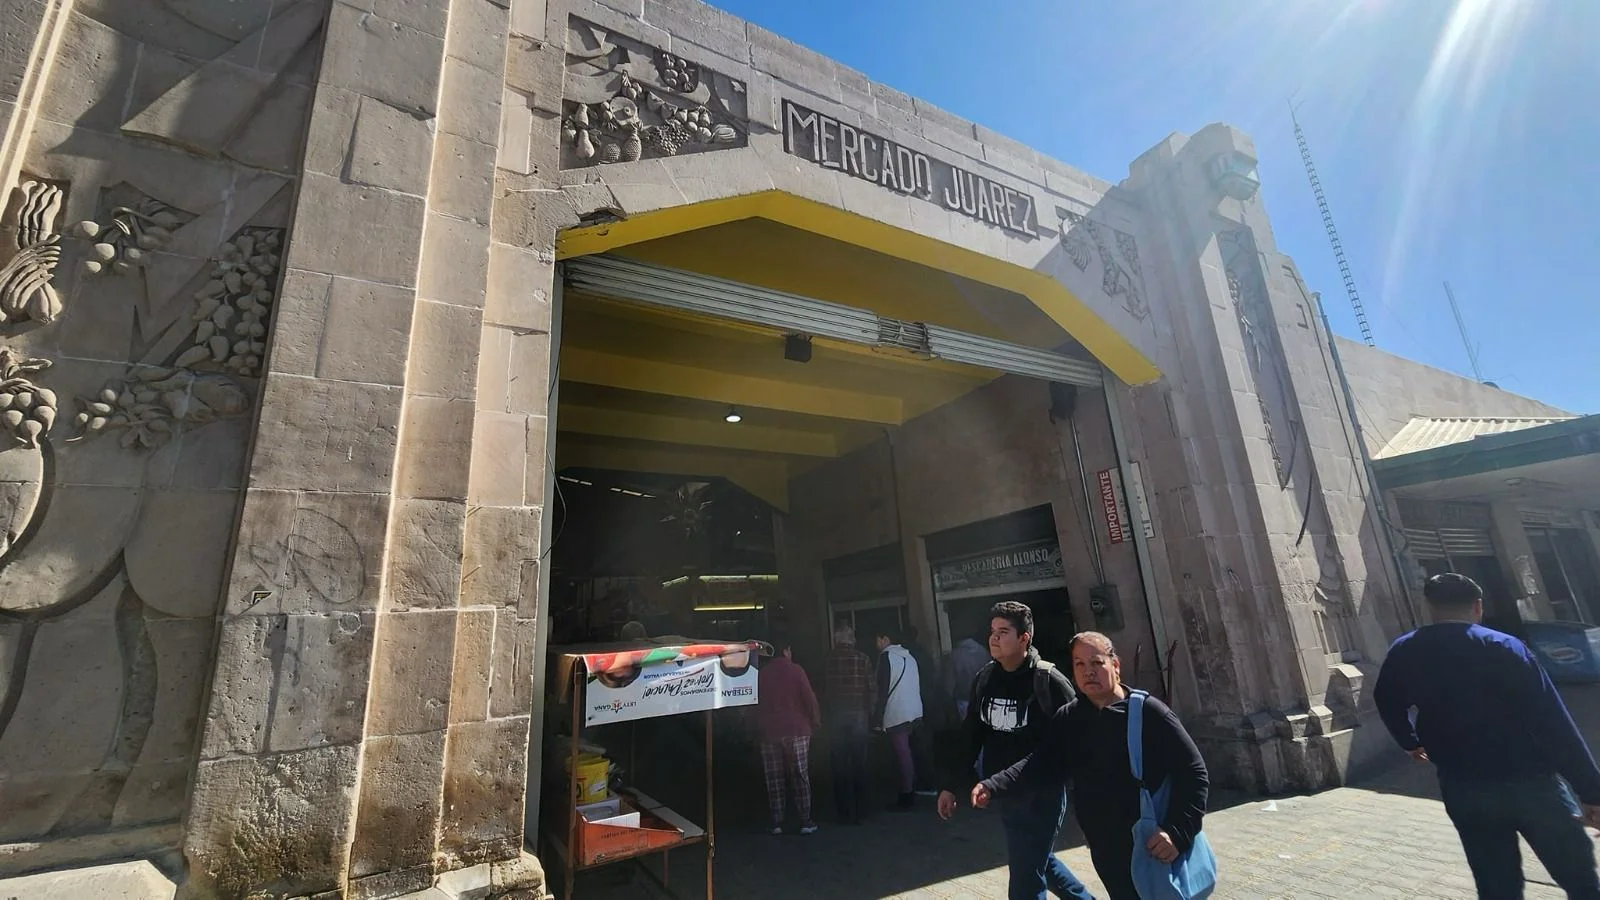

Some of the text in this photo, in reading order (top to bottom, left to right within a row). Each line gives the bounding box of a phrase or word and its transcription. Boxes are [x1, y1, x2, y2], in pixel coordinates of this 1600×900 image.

[787, 102, 1038, 237] MERCADO JUAREZ
[1099, 471, 1121, 541] IMPORTANTE
[1013, 548, 1049, 567] ALONSO
[721, 688, 753, 697] ESTEBAN
